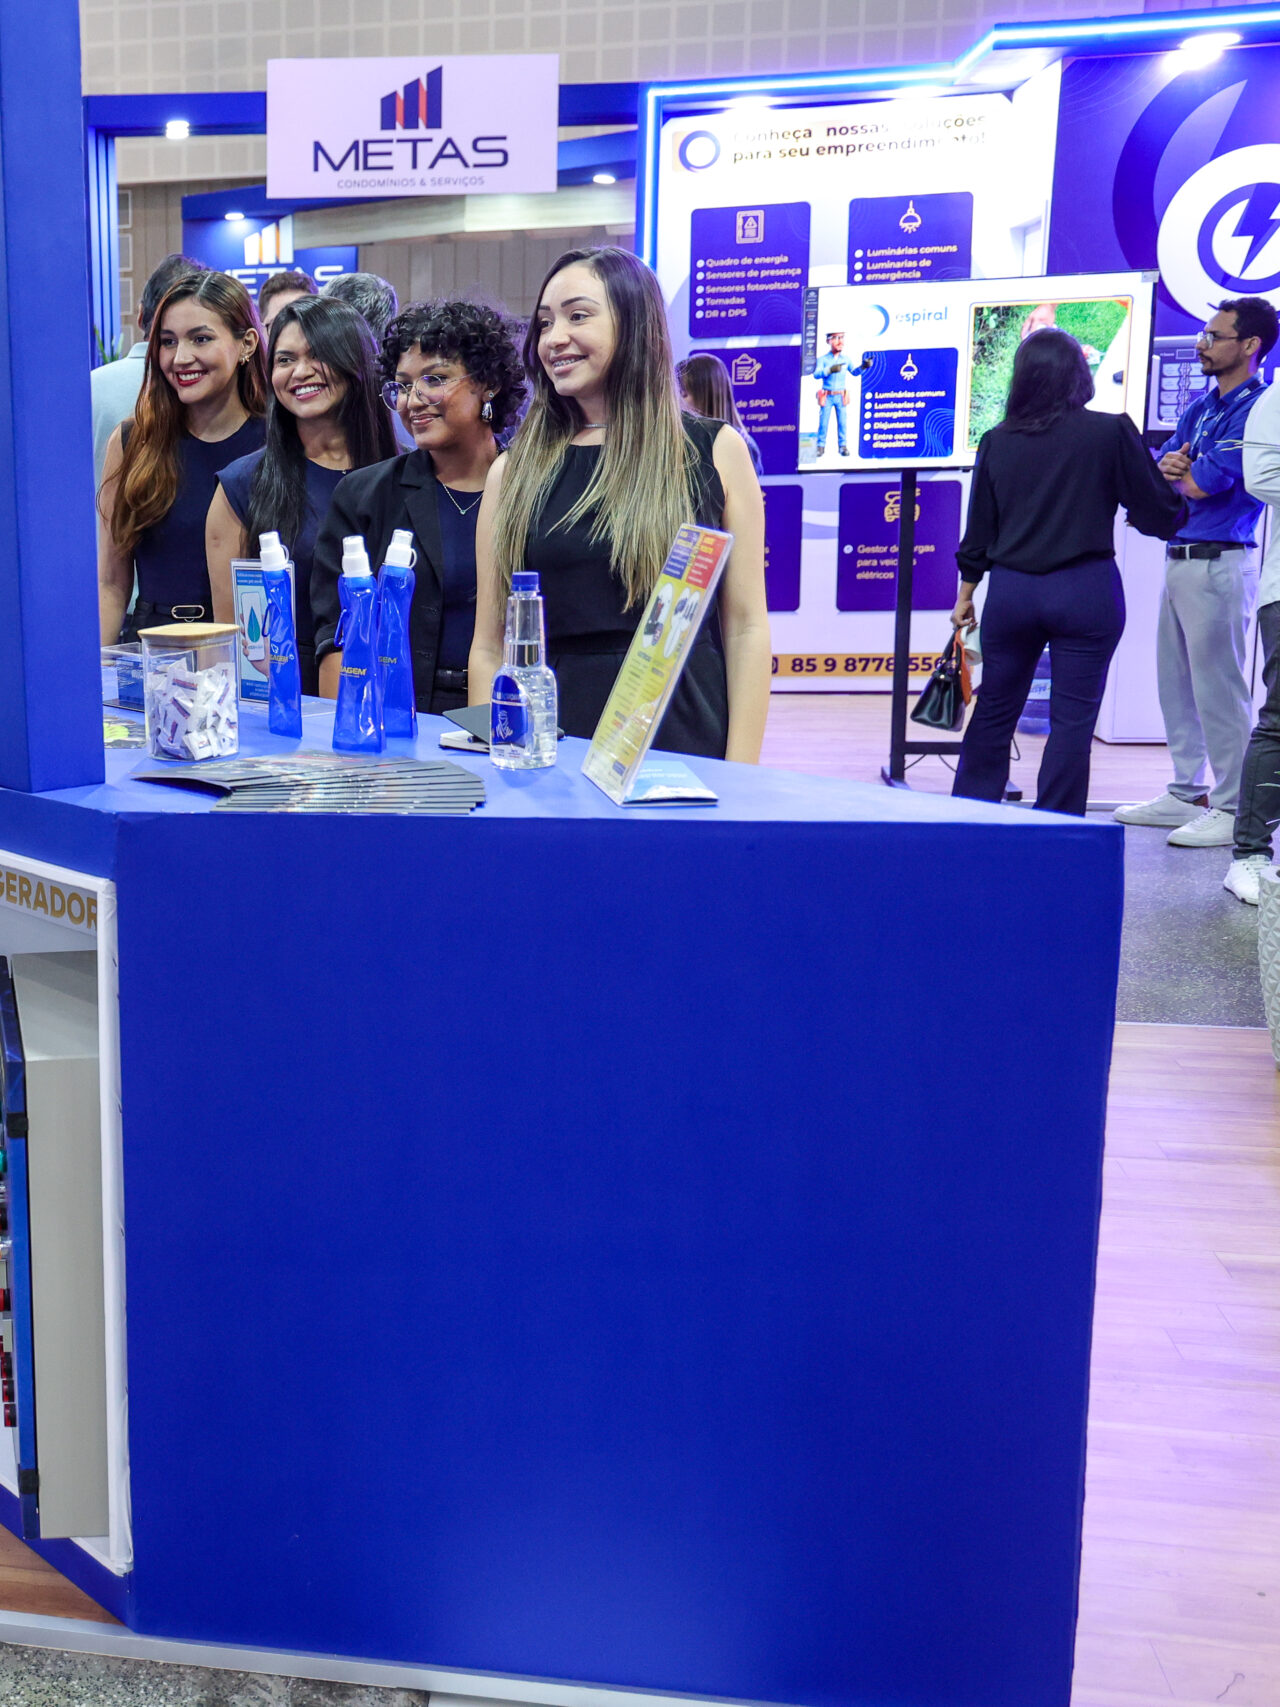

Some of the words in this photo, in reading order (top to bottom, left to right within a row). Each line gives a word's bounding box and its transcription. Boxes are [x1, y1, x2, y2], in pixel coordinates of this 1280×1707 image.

[734, 128, 812, 142] onheça
[313, 135, 509, 172] METAS
[734, 149, 772, 163] para
[779, 147, 810, 158] seu
[337, 177, 416, 189] CONDOMÍNIOS
[419, 177, 427, 187] &
[430, 175, 485, 187] SERVIÇOS
[867, 245, 918, 257] Luminárias
[920, 245, 958, 254] comuns
[706, 257, 739, 268] Quadro
[741, 256, 753, 265] de
[754, 254, 789, 265] energia
[919, 258, 932, 267] de
[705, 271, 746, 280] Sensores
[747, 269, 759, 277] de
[760, 267, 802, 278] presença
[866, 270, 921, 281] emergência
[705, 284, 746, 294] Sensores
[728, 309, 747, 317] DPS
[895, 306, 948, 326] espiral
[916, 390, 946, 398] comuns
[749, 399, 775, 407] SPDA
[746, 413, 769, 422] carga
[857, 545, 888, 554] Gestor
[856, 558, 878, 568] para
[856, 570, 895, 580] elétricos
[791, 658, 817, 672] 85
[824, 657, 837, 672] 9
[844, 657, 895, 672] 8778
